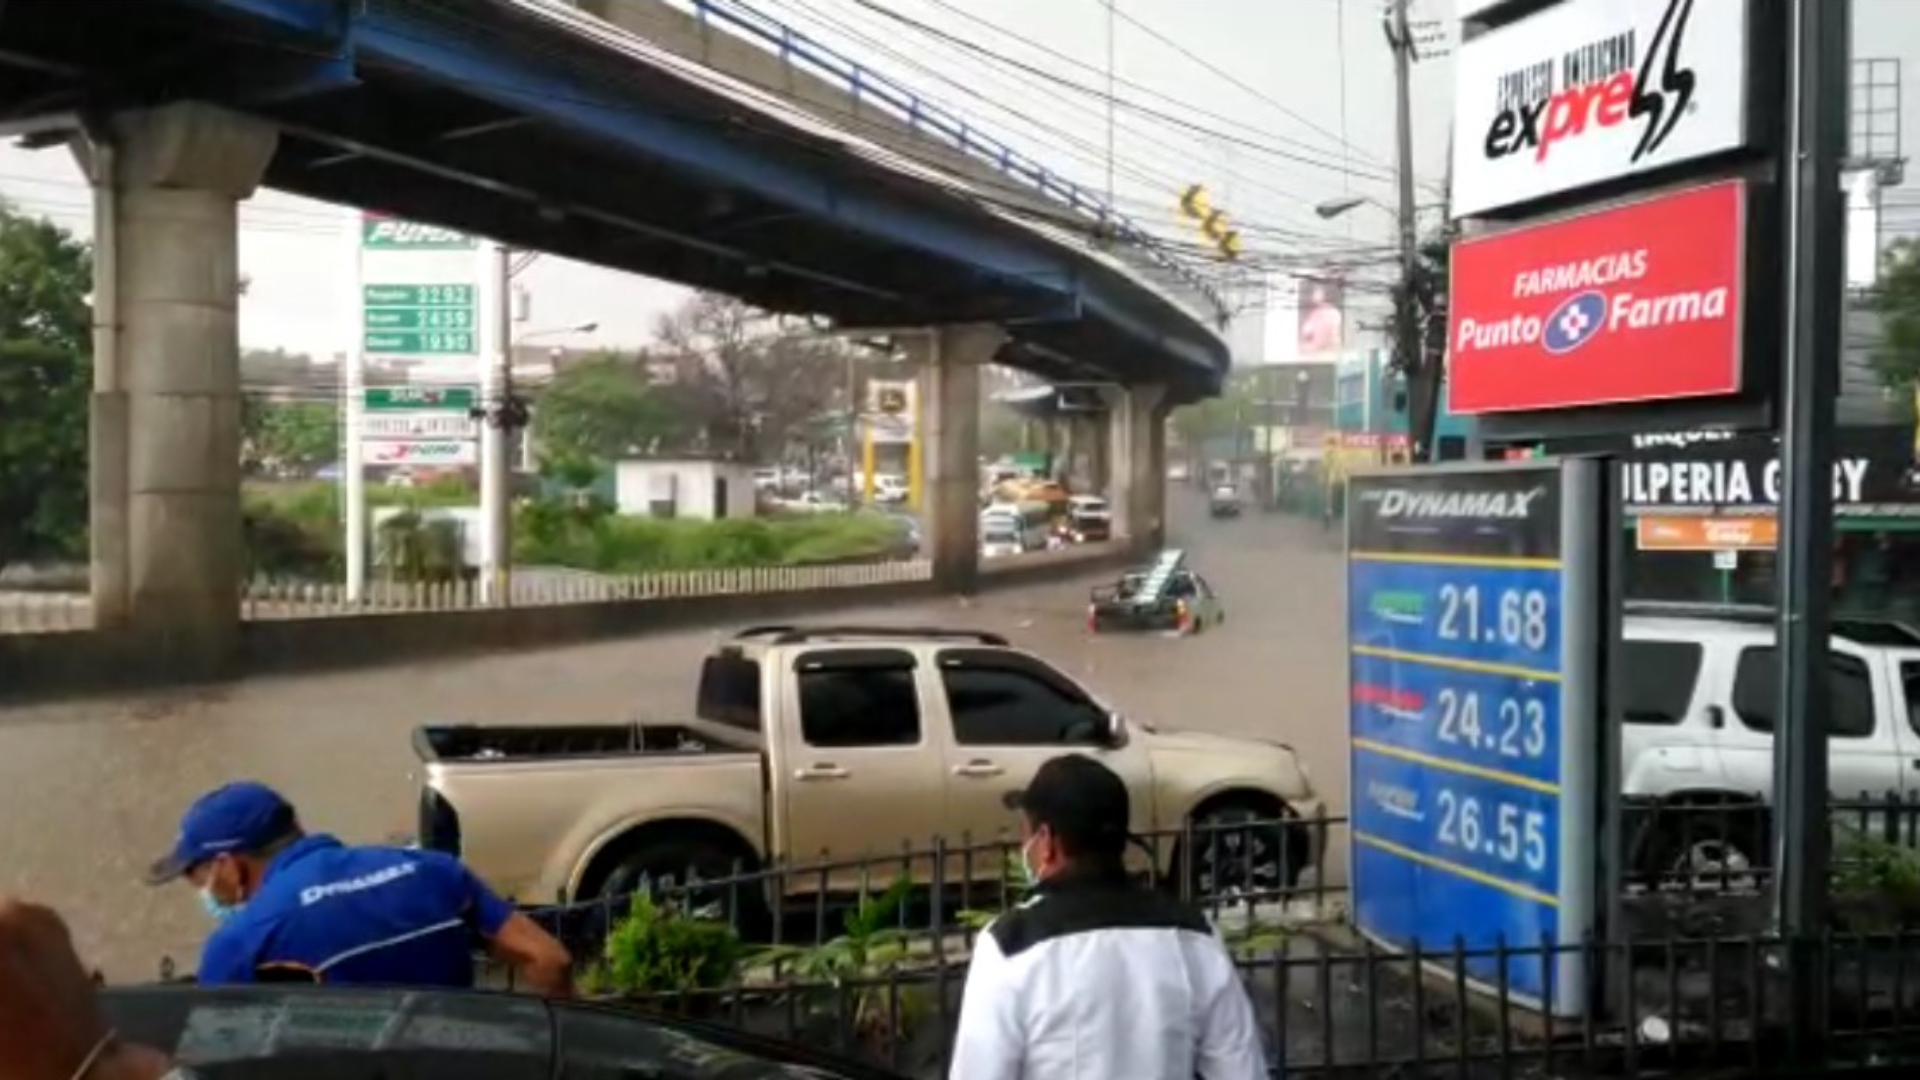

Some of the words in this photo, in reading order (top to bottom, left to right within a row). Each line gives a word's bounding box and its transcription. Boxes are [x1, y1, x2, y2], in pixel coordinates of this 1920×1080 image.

[1513, 250, 1647, 298] FARMACIAS
[1458, 314, 1540, 351] Punto
[1609, 286, 1728, 331] Farma
[1378, 485, 1545, 517] DYNAMAX
[1622, 459, 1752, 502] LPERIA
[1438, 582, 1547, 649] 21.68
[1438, 687, 1546, 757] 24.23
[1437, 789, 1546, 881] 26.55
